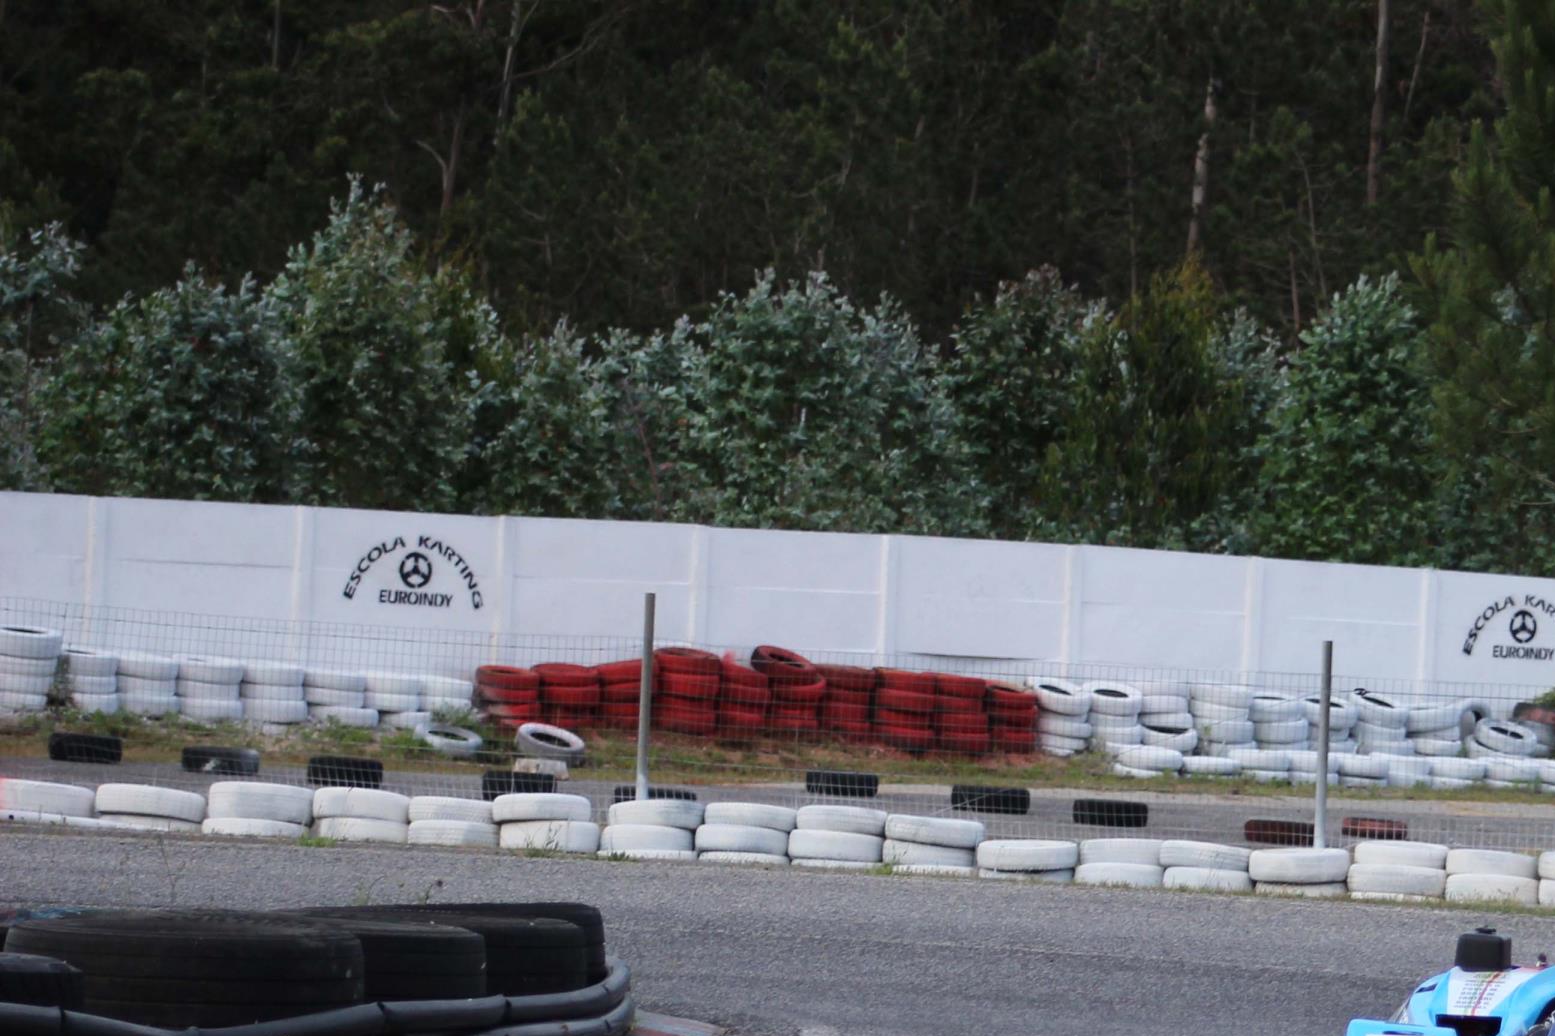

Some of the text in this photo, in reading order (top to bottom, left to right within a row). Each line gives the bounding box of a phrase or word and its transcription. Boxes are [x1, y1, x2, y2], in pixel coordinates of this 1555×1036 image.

[343, 535, 483, 610] ESCOLA KARTING
[378, 589, 453, 607] EUROINDY
[1462, 595, 1516, 656] ESCOLA
[1492, 644, 1555, 661] EUROINDY
